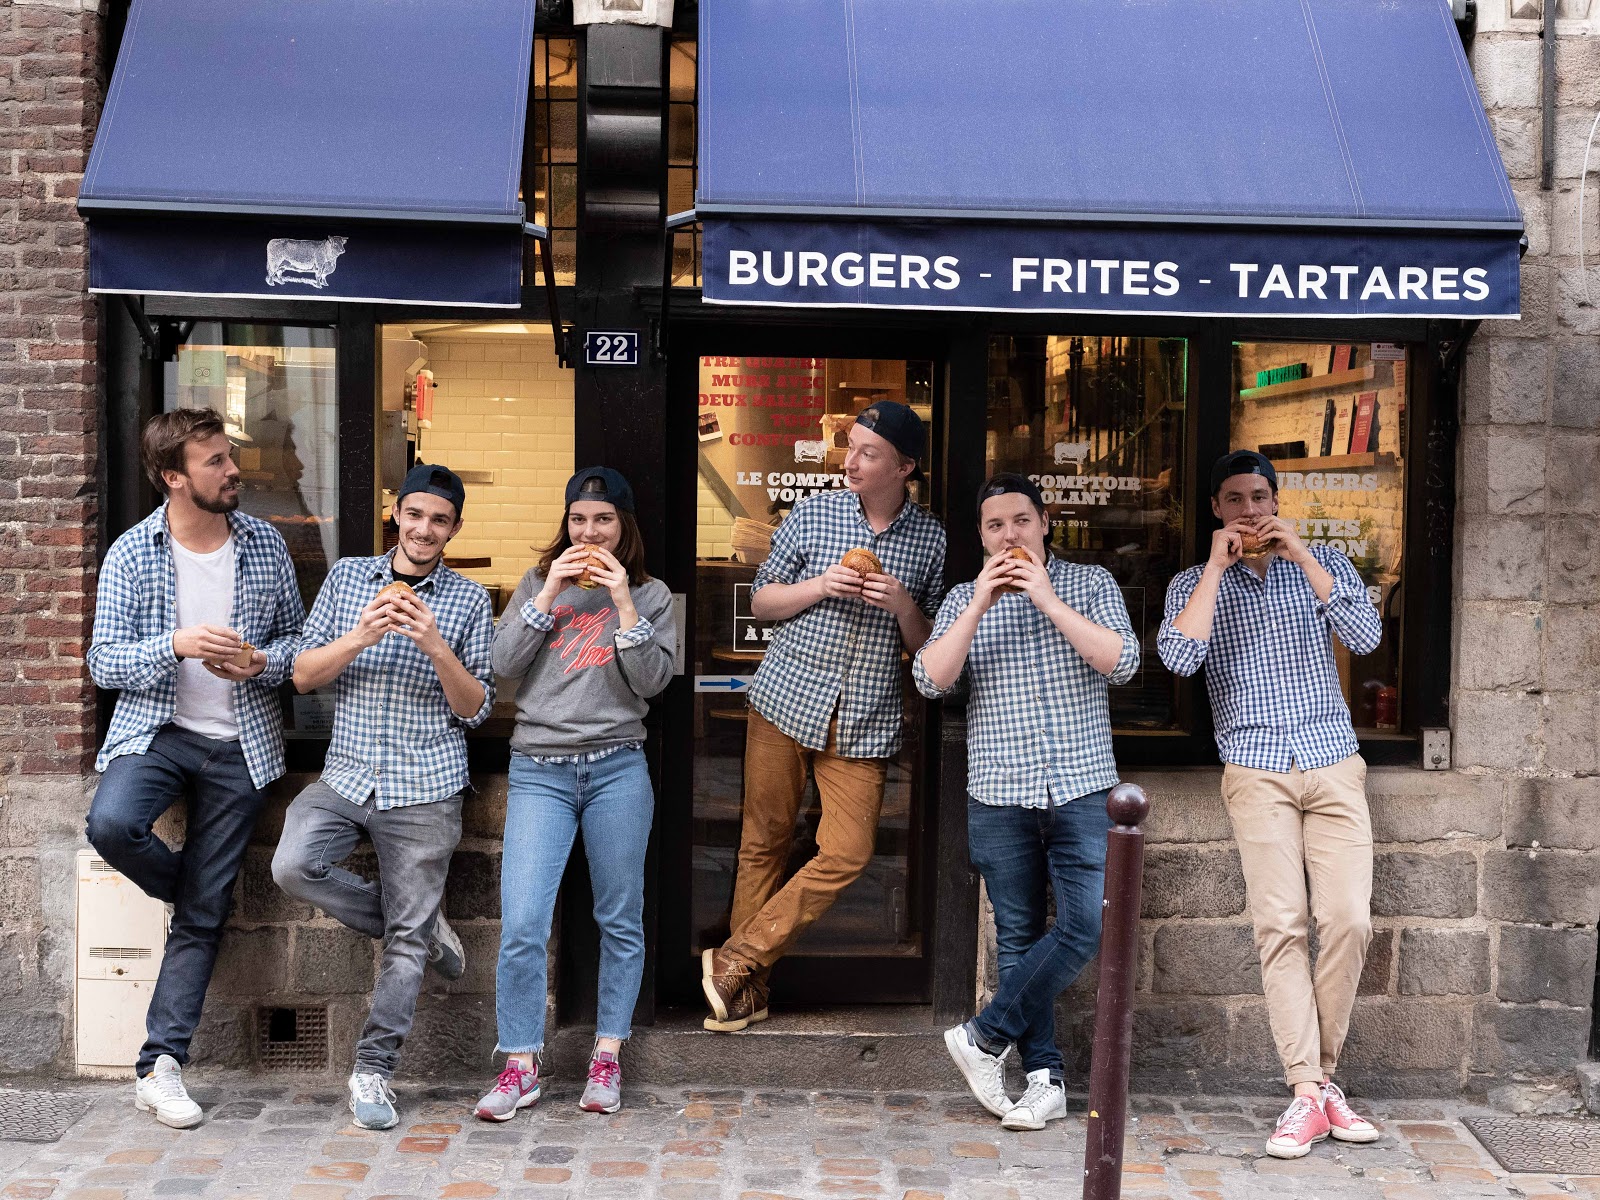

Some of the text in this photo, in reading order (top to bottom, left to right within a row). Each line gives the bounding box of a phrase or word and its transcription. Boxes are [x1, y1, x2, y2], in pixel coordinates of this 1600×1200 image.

[729, 250, 961, 290] BURGERS
[1012, 257, 1181, 297] FRITES
[1229, 263, 1490, 301] TARTARES
[596, 336, 628, 361] 22
[745, 357, 825, 370] QUATRE
[711, 374, 825, 389] MURS AVEC
[698, 393, 826, 409] DEUX SALLES
[736, 471, 763, 486] LE
[1068, 519, 1089, 528] 2013
[744, 624, 759, 641] À
